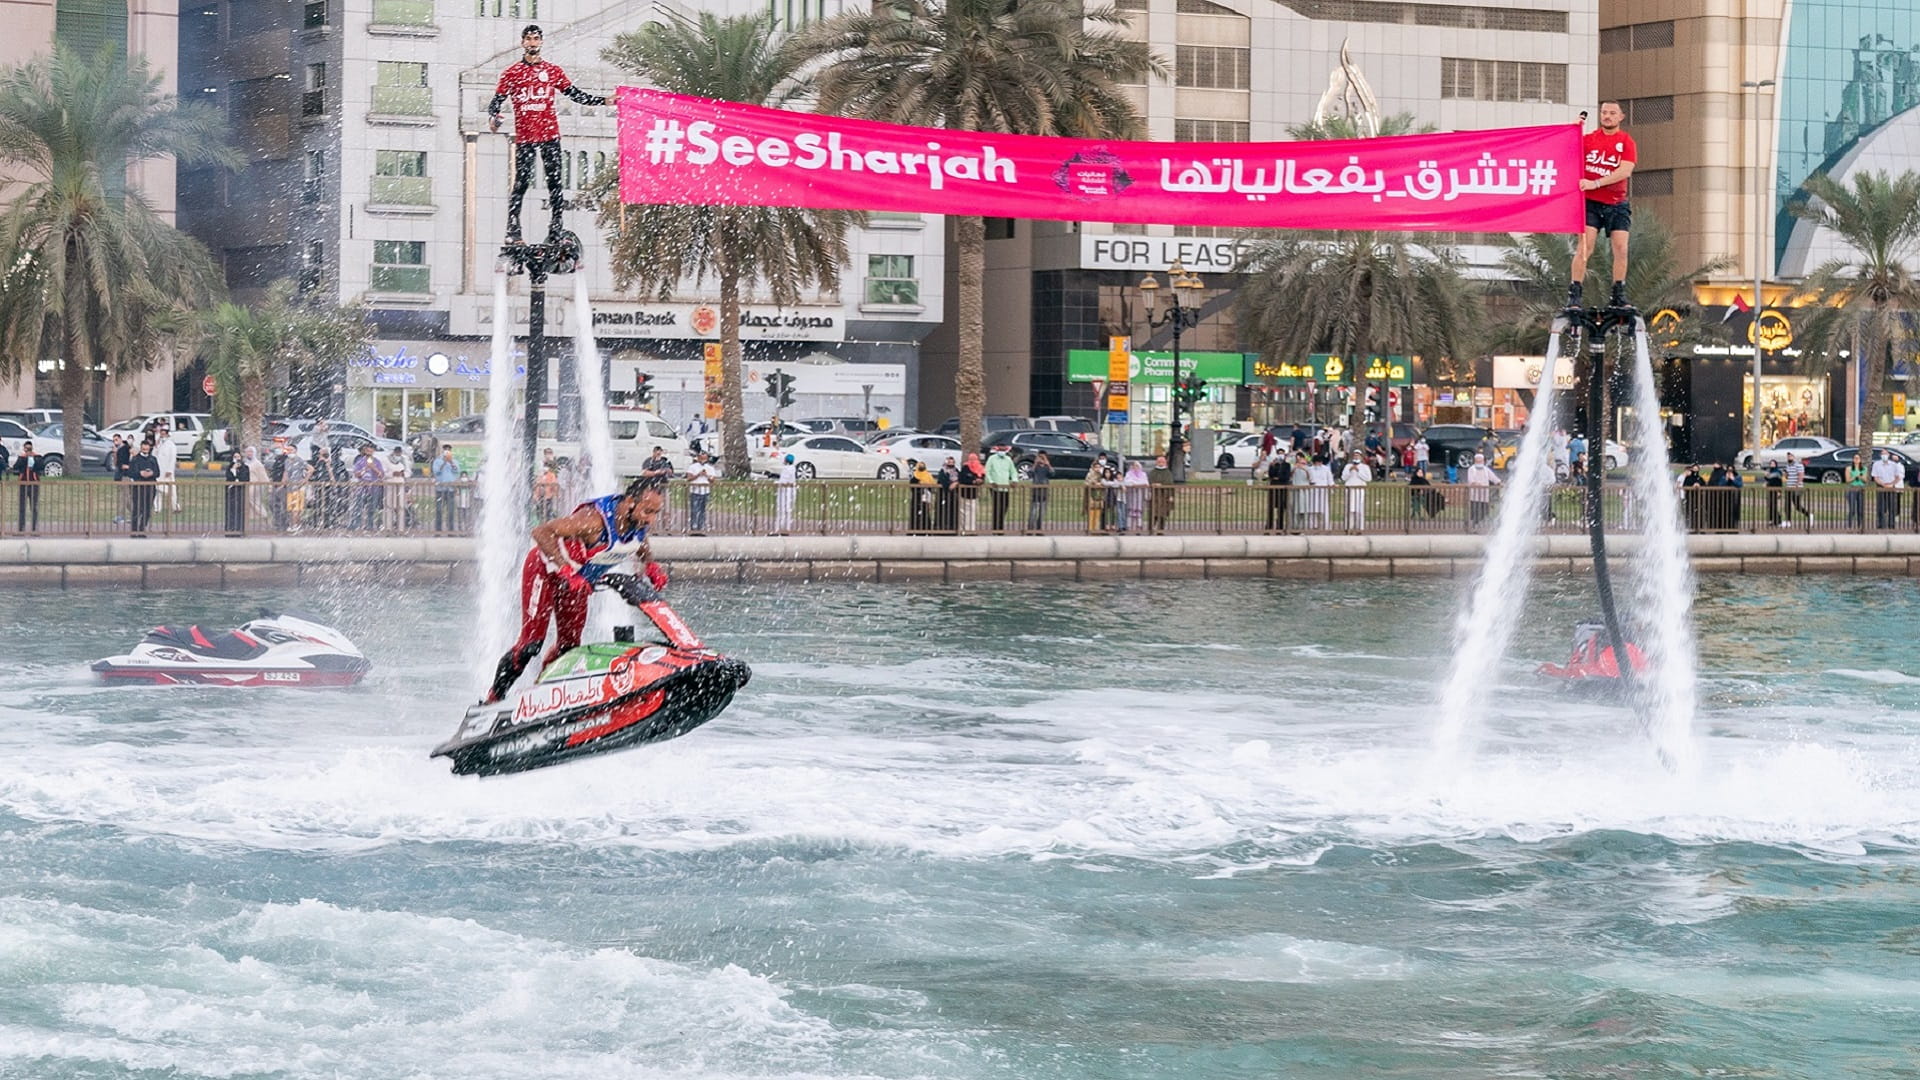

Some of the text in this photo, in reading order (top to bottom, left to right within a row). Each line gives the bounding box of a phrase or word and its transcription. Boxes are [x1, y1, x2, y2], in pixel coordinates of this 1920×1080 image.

[644, 119, 1018, 190] #SeeSharjah
[1160, 152, 1557, 203] #تشرق_بفعالياتها
[1094, 240, 1151, 264] FOR
[592, 308, 677, 326] jman Bank
[1143, 357, 1198, 372] Commnity
[1143, 369, 1191, 379] Pharmcy
